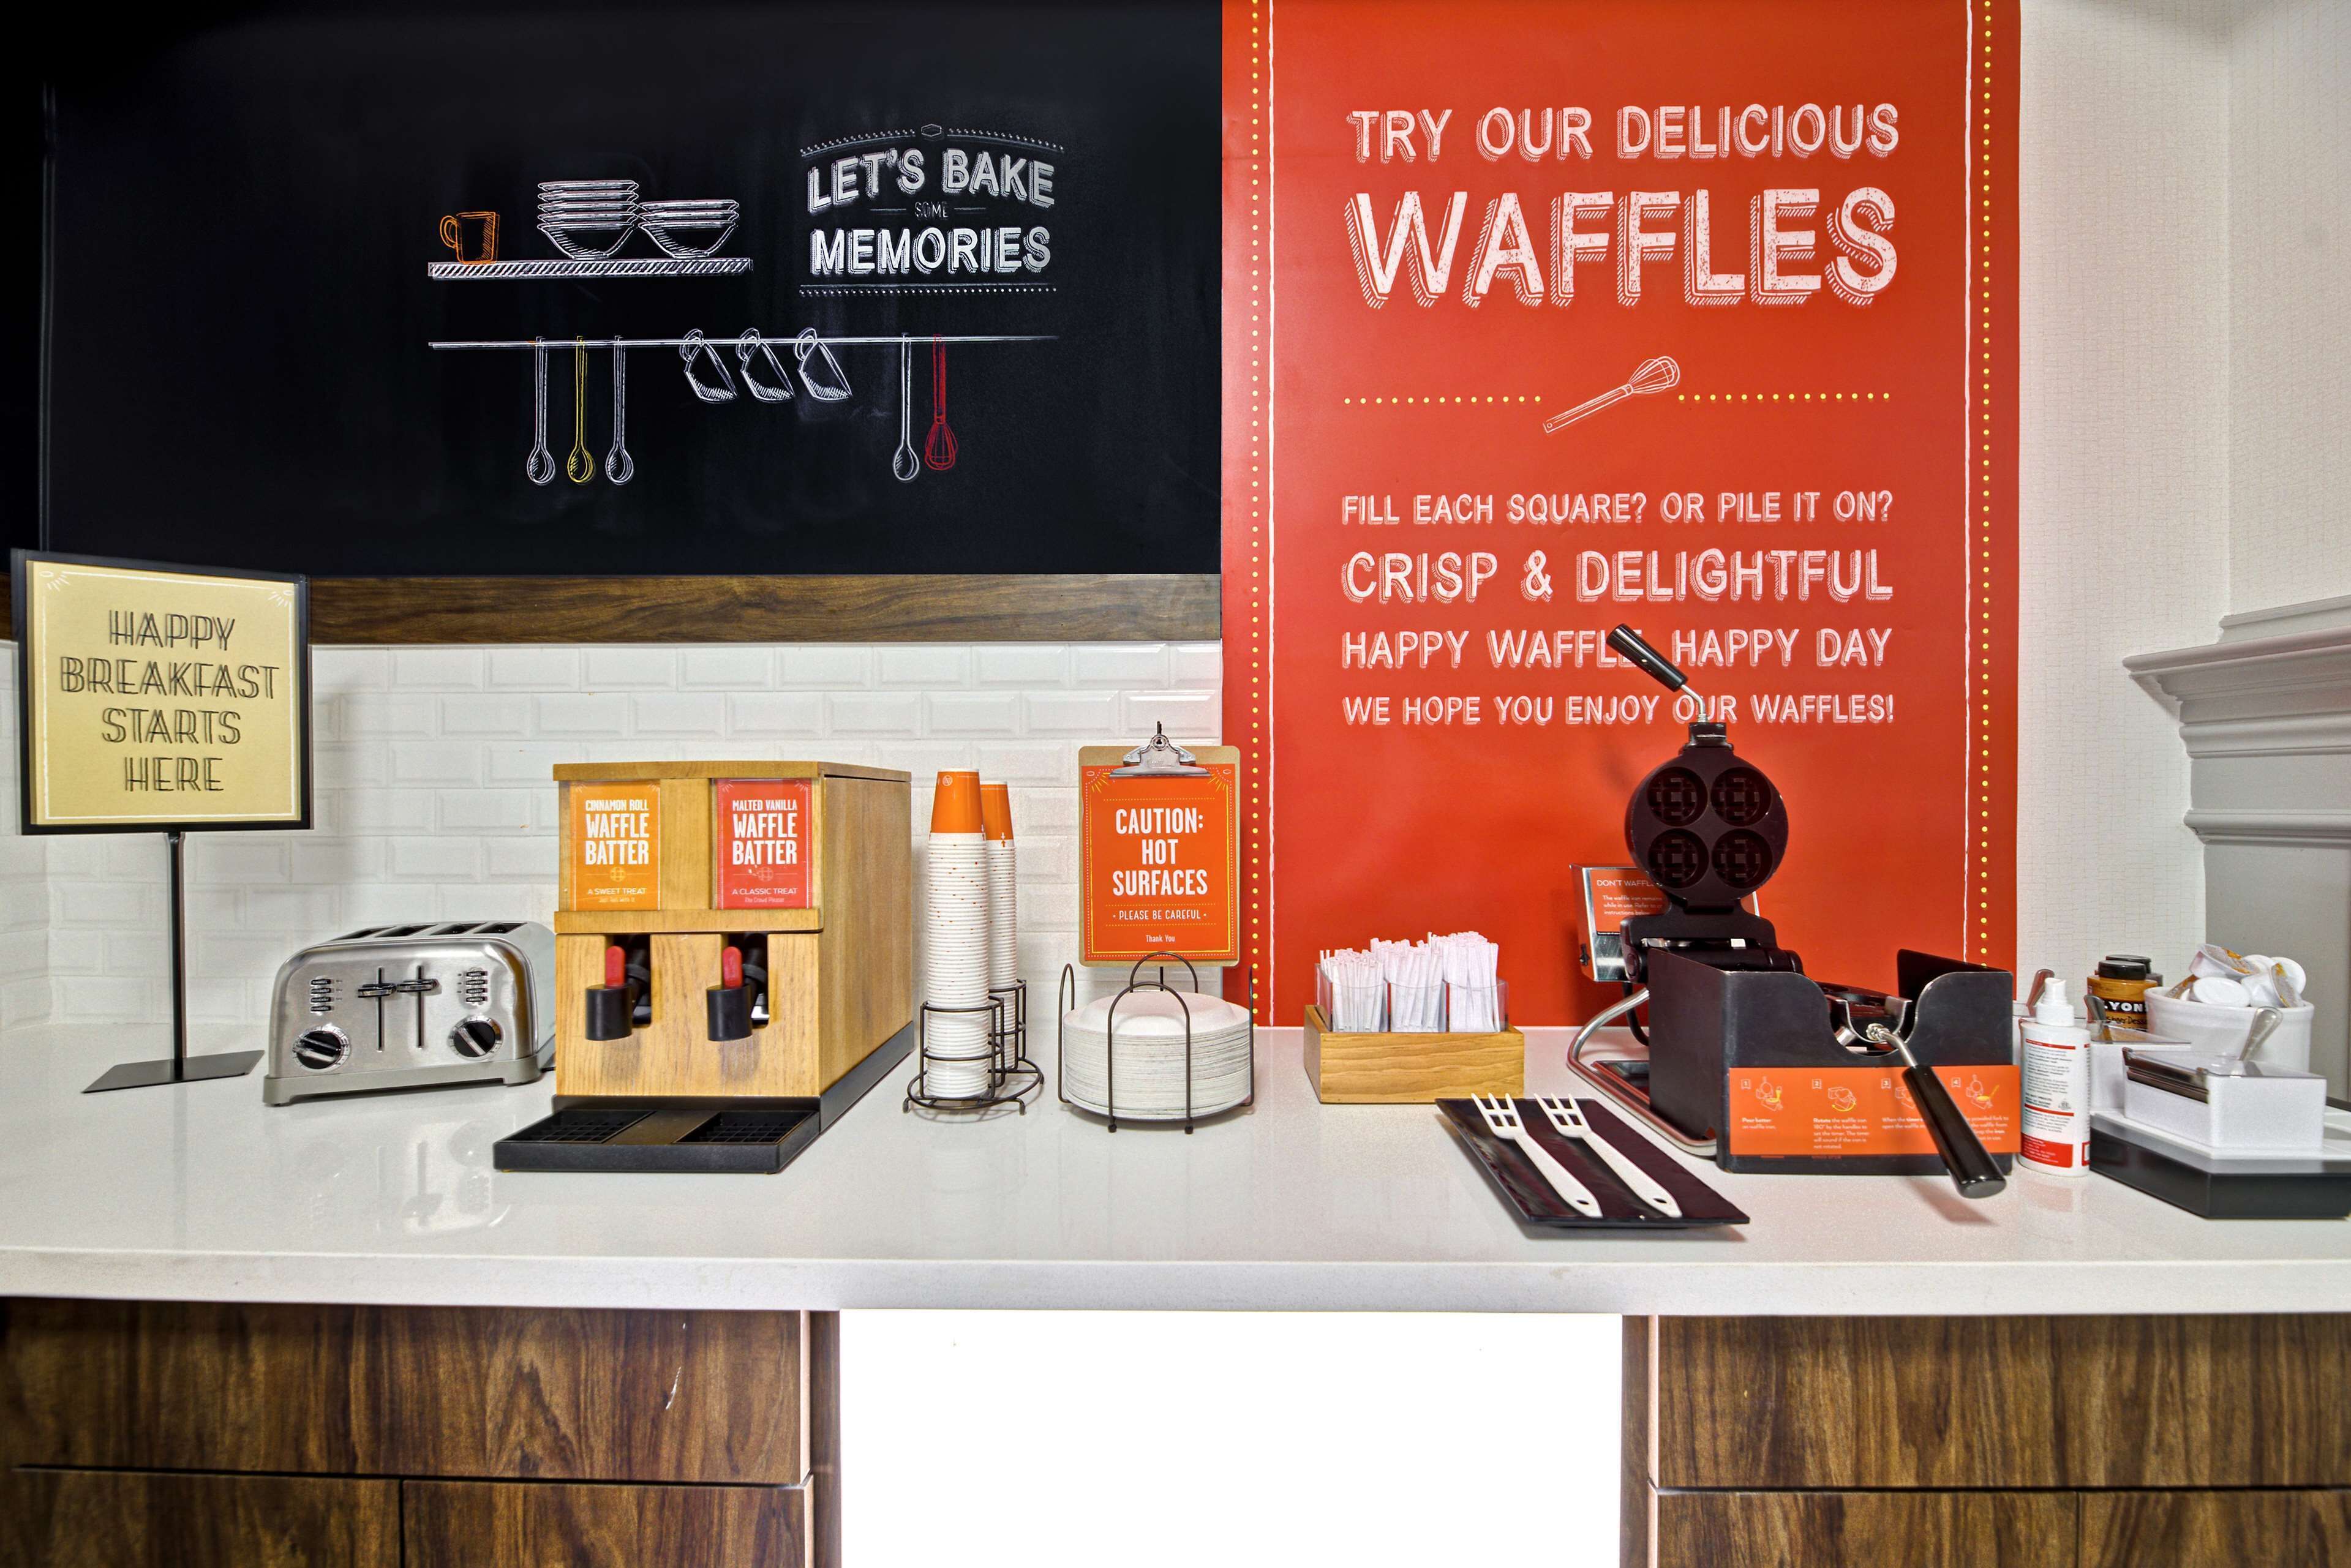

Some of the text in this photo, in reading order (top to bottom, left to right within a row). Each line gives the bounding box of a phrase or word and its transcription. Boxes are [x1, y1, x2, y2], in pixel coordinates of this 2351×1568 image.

[1347, 103, 1899, 163] TRY OUR DELICIOUS
[808, 148, 1055, 214] LET'S BAKE
[915, 201, 949, 219] SOME
[810, 227, 1051, 276] MEMORIES
[1344, 187, 1897, 309] WAFFLES
[1342, 490, 1893, 525] FILL EACH SQUARE? OR PILE IT ON?
[1342, 549, 1894, 604] CRISP & DELIGHTFUL
[110, 610, 235, 651] HAPPY
[1342, 631, 1470, 669] HAPPY
[1671, 629, 1800, 668] HAPPY
[1817, 628, 1893, 667] DAY
[61, 657, 279, 699] BREAKFAST
[1342, 695, 1894, 726] WE HOPE YOU ENJOY OUR WAFFLES!
[102, 708, 241, 745] STARTS
[125, 757, 224, 792] HERE
[585, 800, 649, 811] CINNAMON ROLL
[732, 800, 797, 811] MALTED VANILLA
[586, 813, 650, 838] WAFFLE
[733, 813, 797, 838] WAFFLE
[1115, 808, 1203, 835] CAUTION:
[585, 839, 649, 865] BATTER
[732, 839, 797, 865] BATTER
[1142, 839, 1179, 865] HOT
[1112, 869, 1208, 896] SURFACES
[1119, 909, 1201, 920] PLEASE BE CAREFUL
[1146, 934, 1163, 943] Thank
[2104, 1001, 2143, 1012] YON
